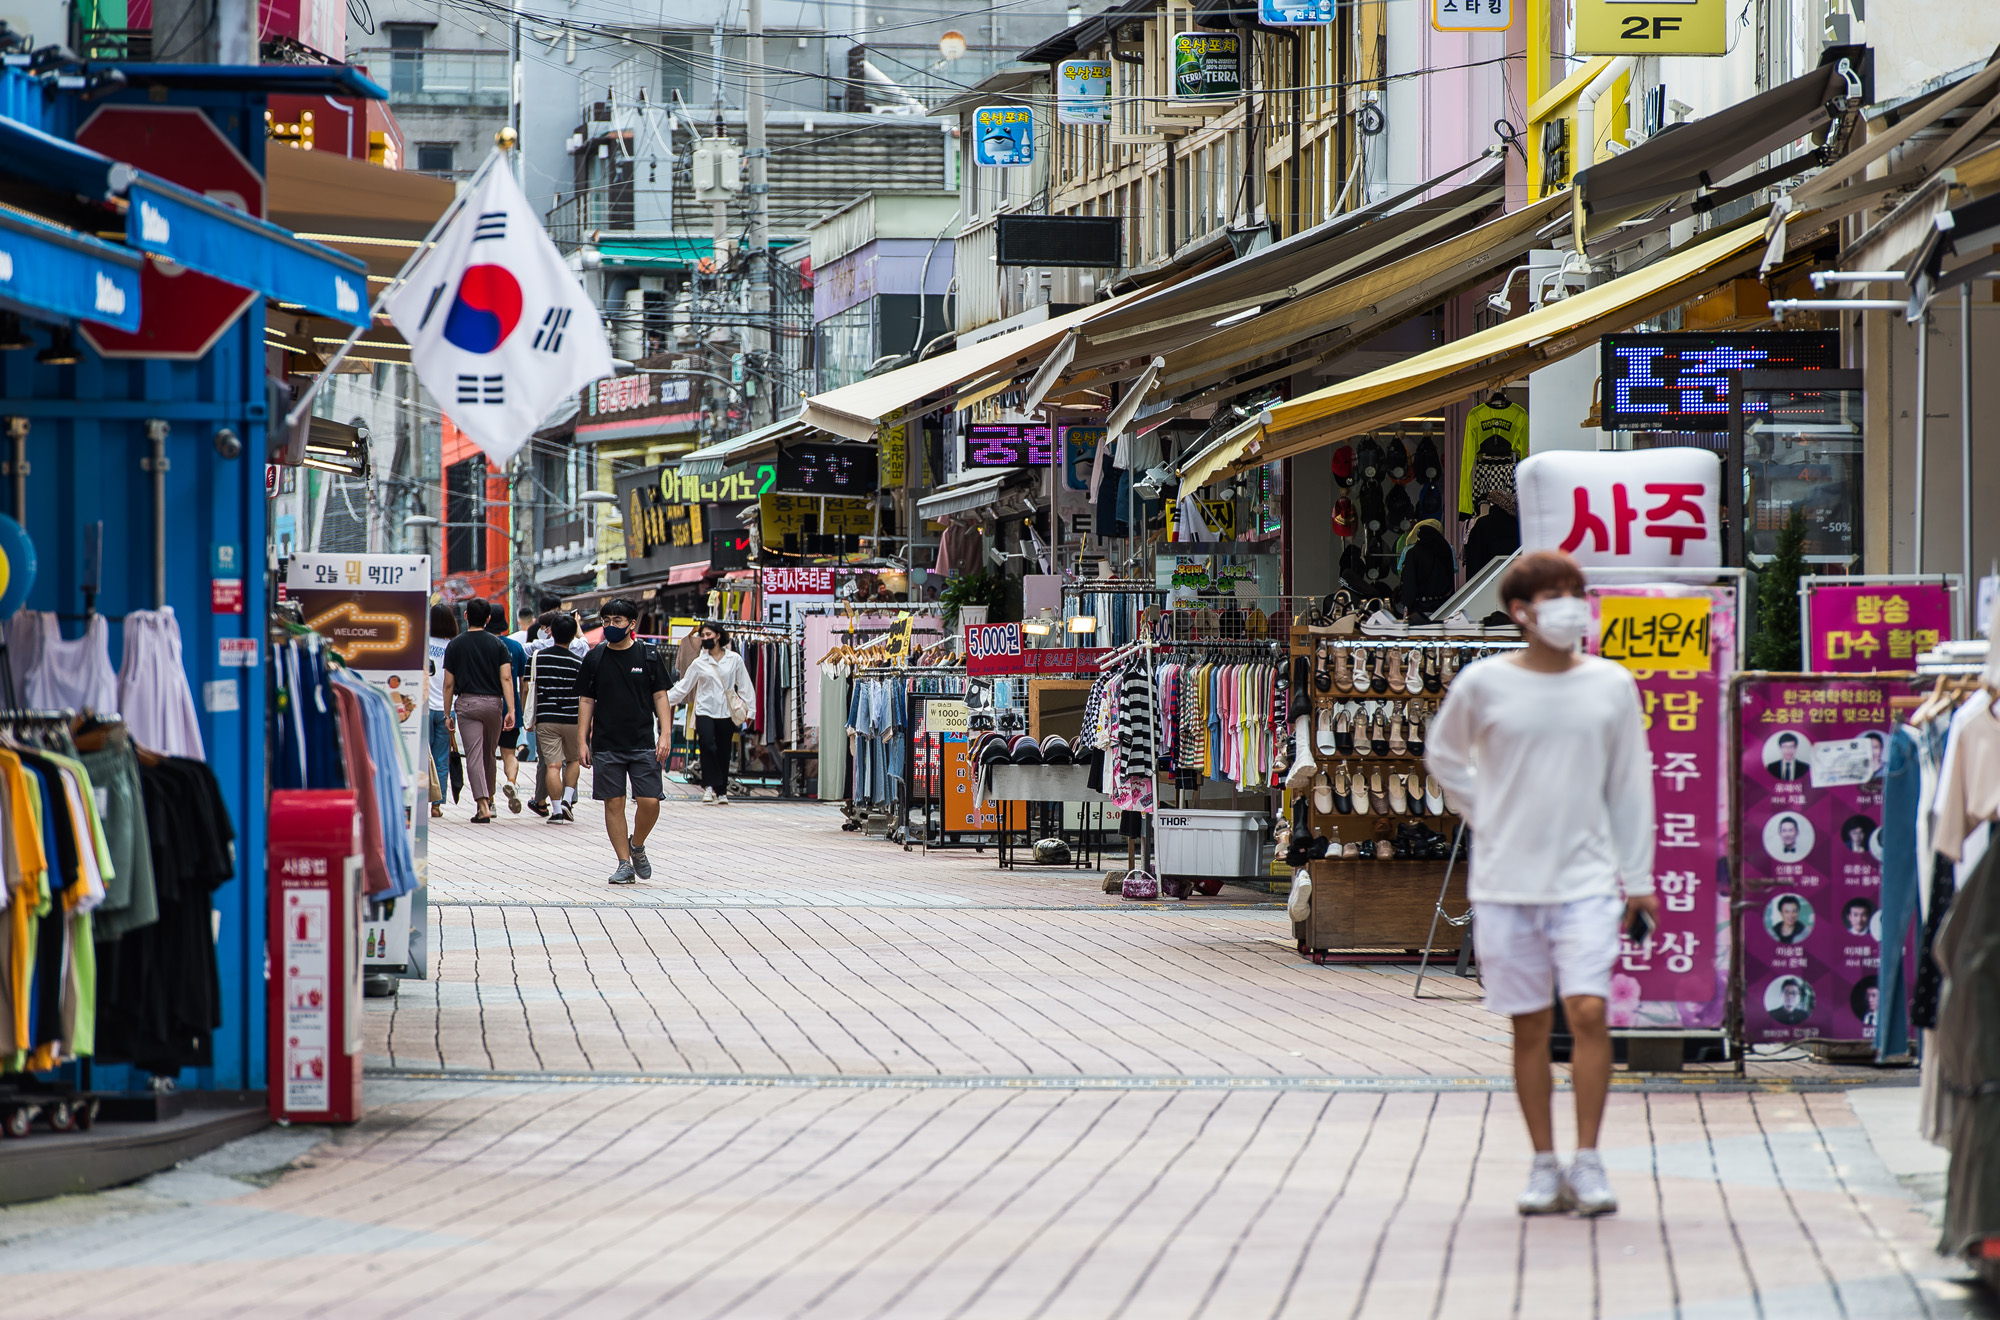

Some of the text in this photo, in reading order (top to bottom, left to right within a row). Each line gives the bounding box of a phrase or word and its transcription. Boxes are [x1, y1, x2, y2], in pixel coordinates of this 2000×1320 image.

[1621, 16, 1682, 39] 2F
[1179, 39, 1236, 54] 옥상포차
[1205, 71, 1238, 83] TERRA
[979, 112, 1029, 125] 옥상포차
[1559, 483, 1707, 555] 사주
[315, 560, 403, 585] 오늘 뭐 먹지?
[767, 571, 831, 592] 홍대사주타로
[1223, 566, 1246, 578] 나의
[1856, 594, 1910, 624] 방송
[333, 628, 378, 637] WELCOME
[968, 623, 1020, 660] 5,000원
[1601, 613, 1710, 660] 신년운세
[1827, 630, 1880, 659] 다수
[1044, 653, 1074, 666] SALE
[946, 718, 967, 727] 3000
[1760, 707, 1804, 724] 소중한
[281, 857, 327, 877] 사용법
